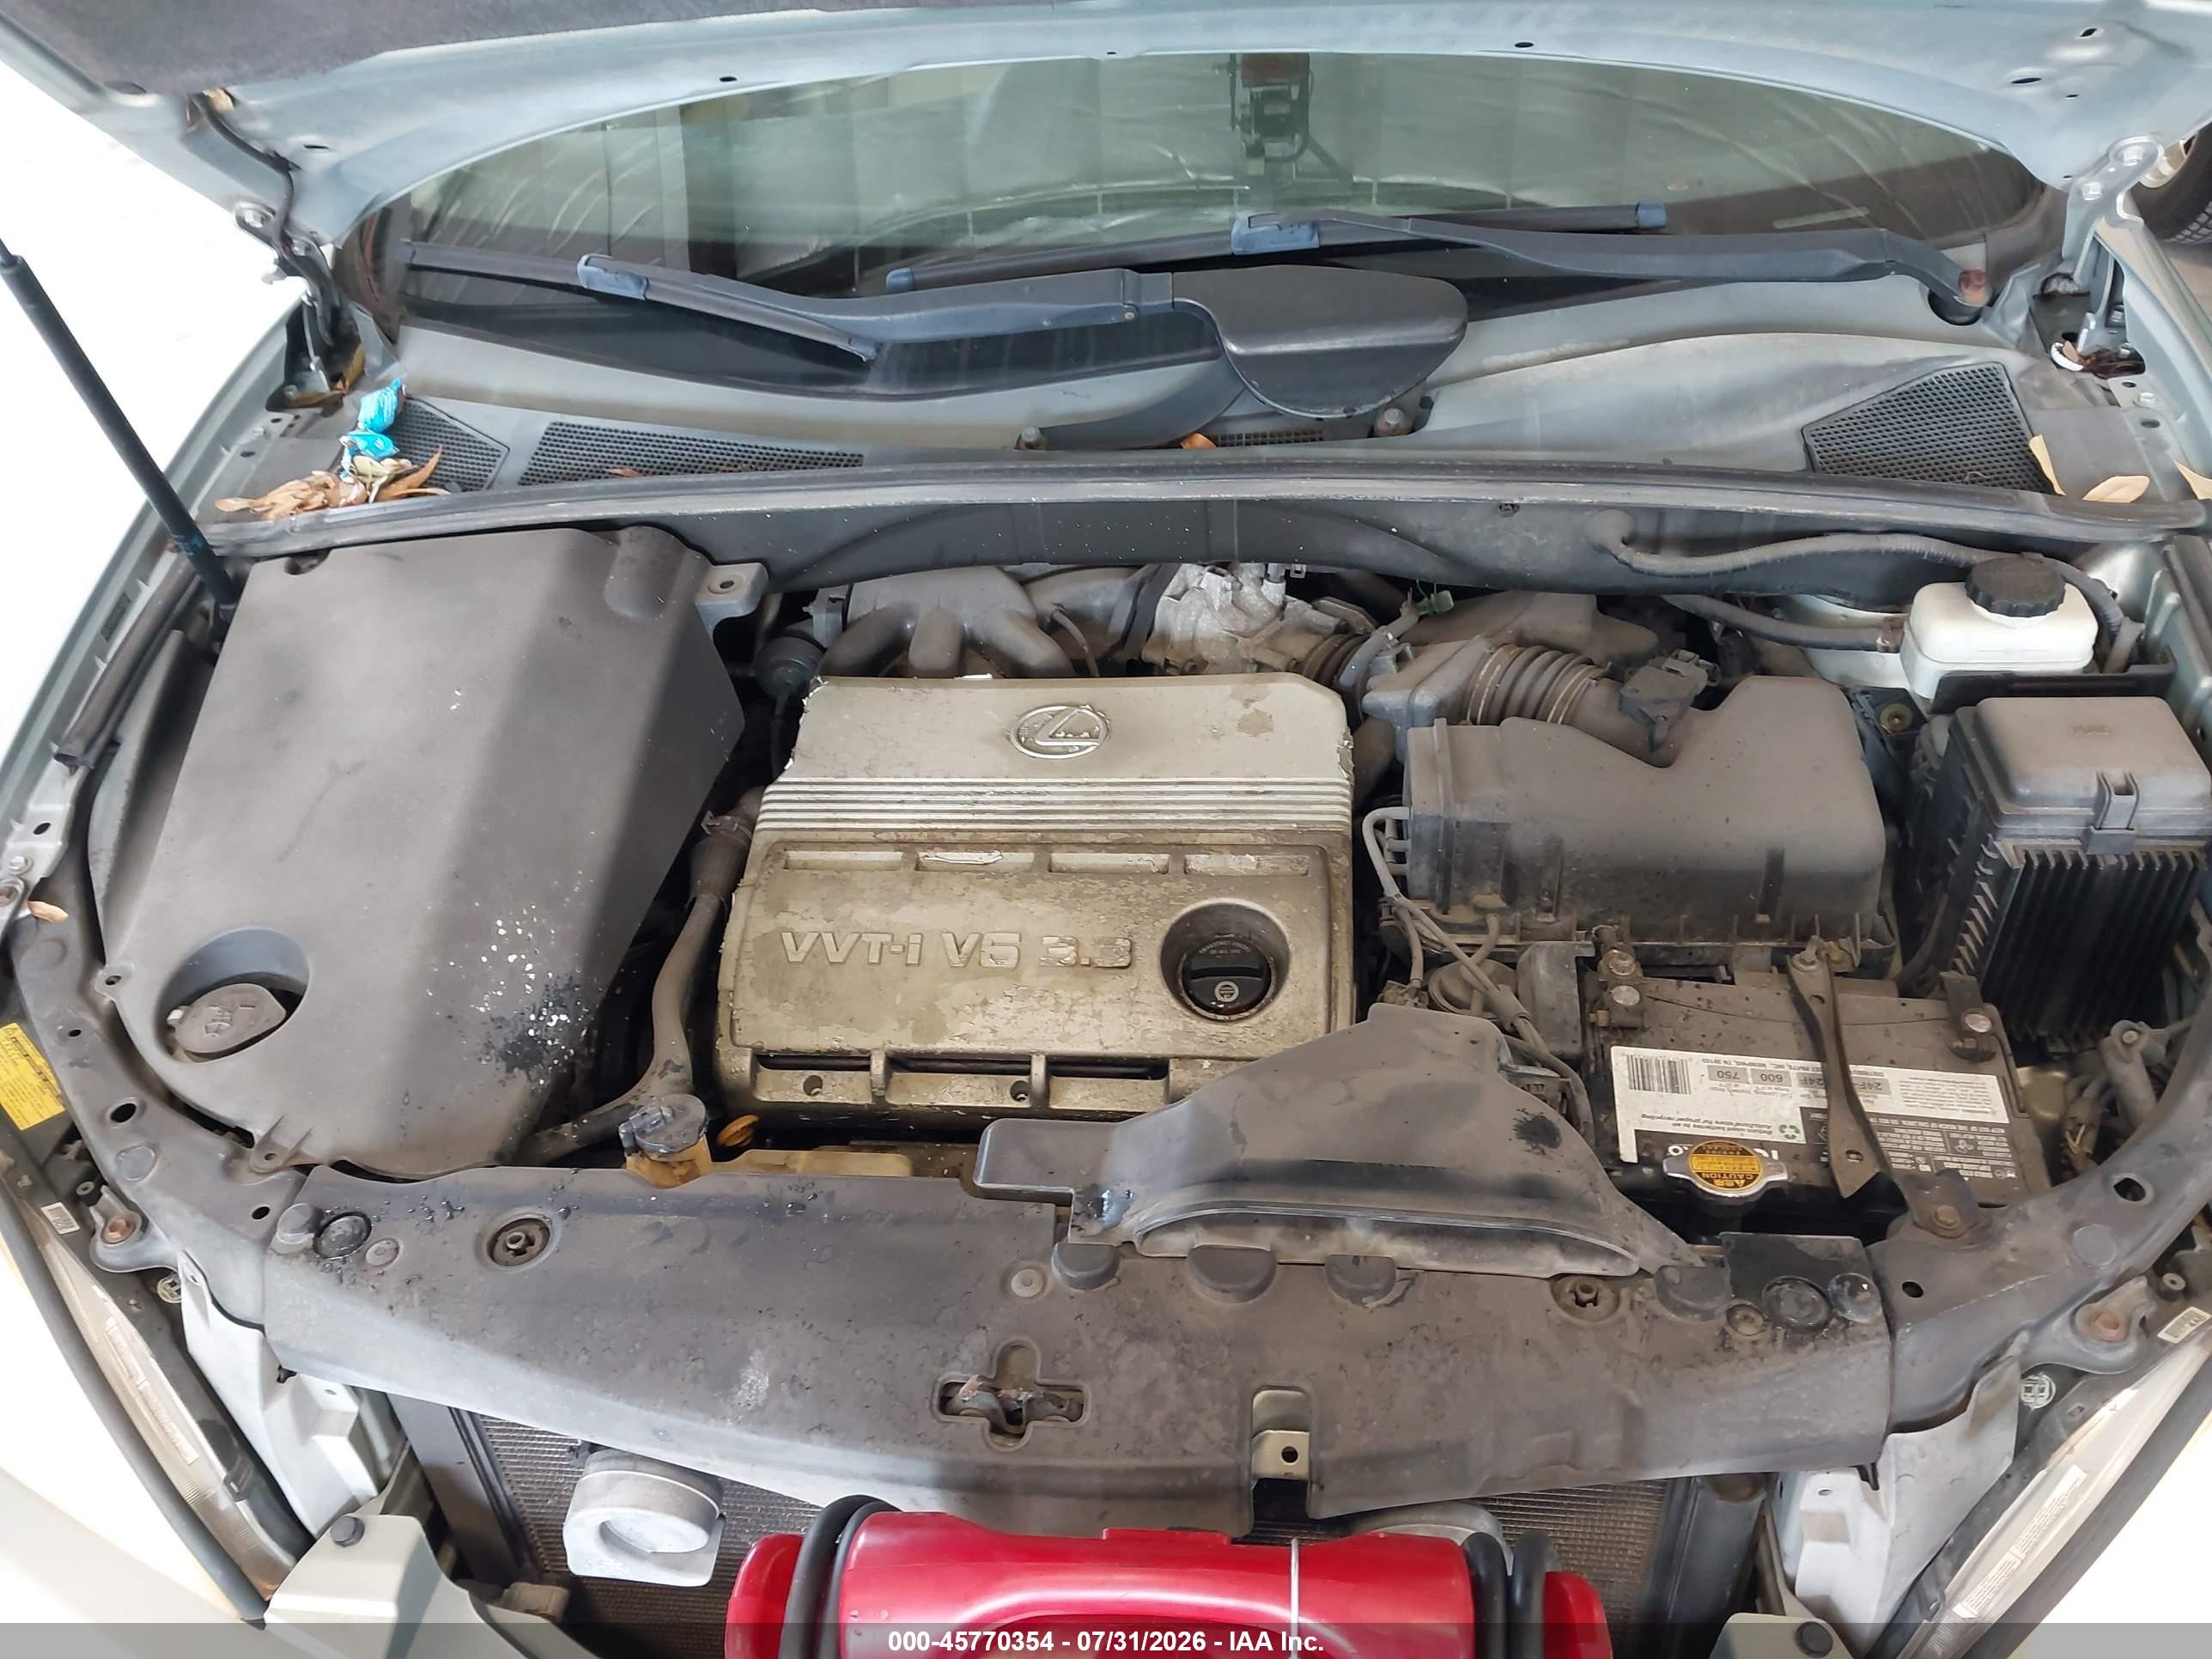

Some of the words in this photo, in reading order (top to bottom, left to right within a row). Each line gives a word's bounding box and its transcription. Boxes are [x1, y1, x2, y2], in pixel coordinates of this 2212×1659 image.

[781, 931, 923, 967] VVT-i
[942, 931, 1022, 969] V6
[1039, 935, 1133, 969] 3.3
[1717, 1071, 1741, 1080] 750
[1760, 1074, 1783, 1083] 600
